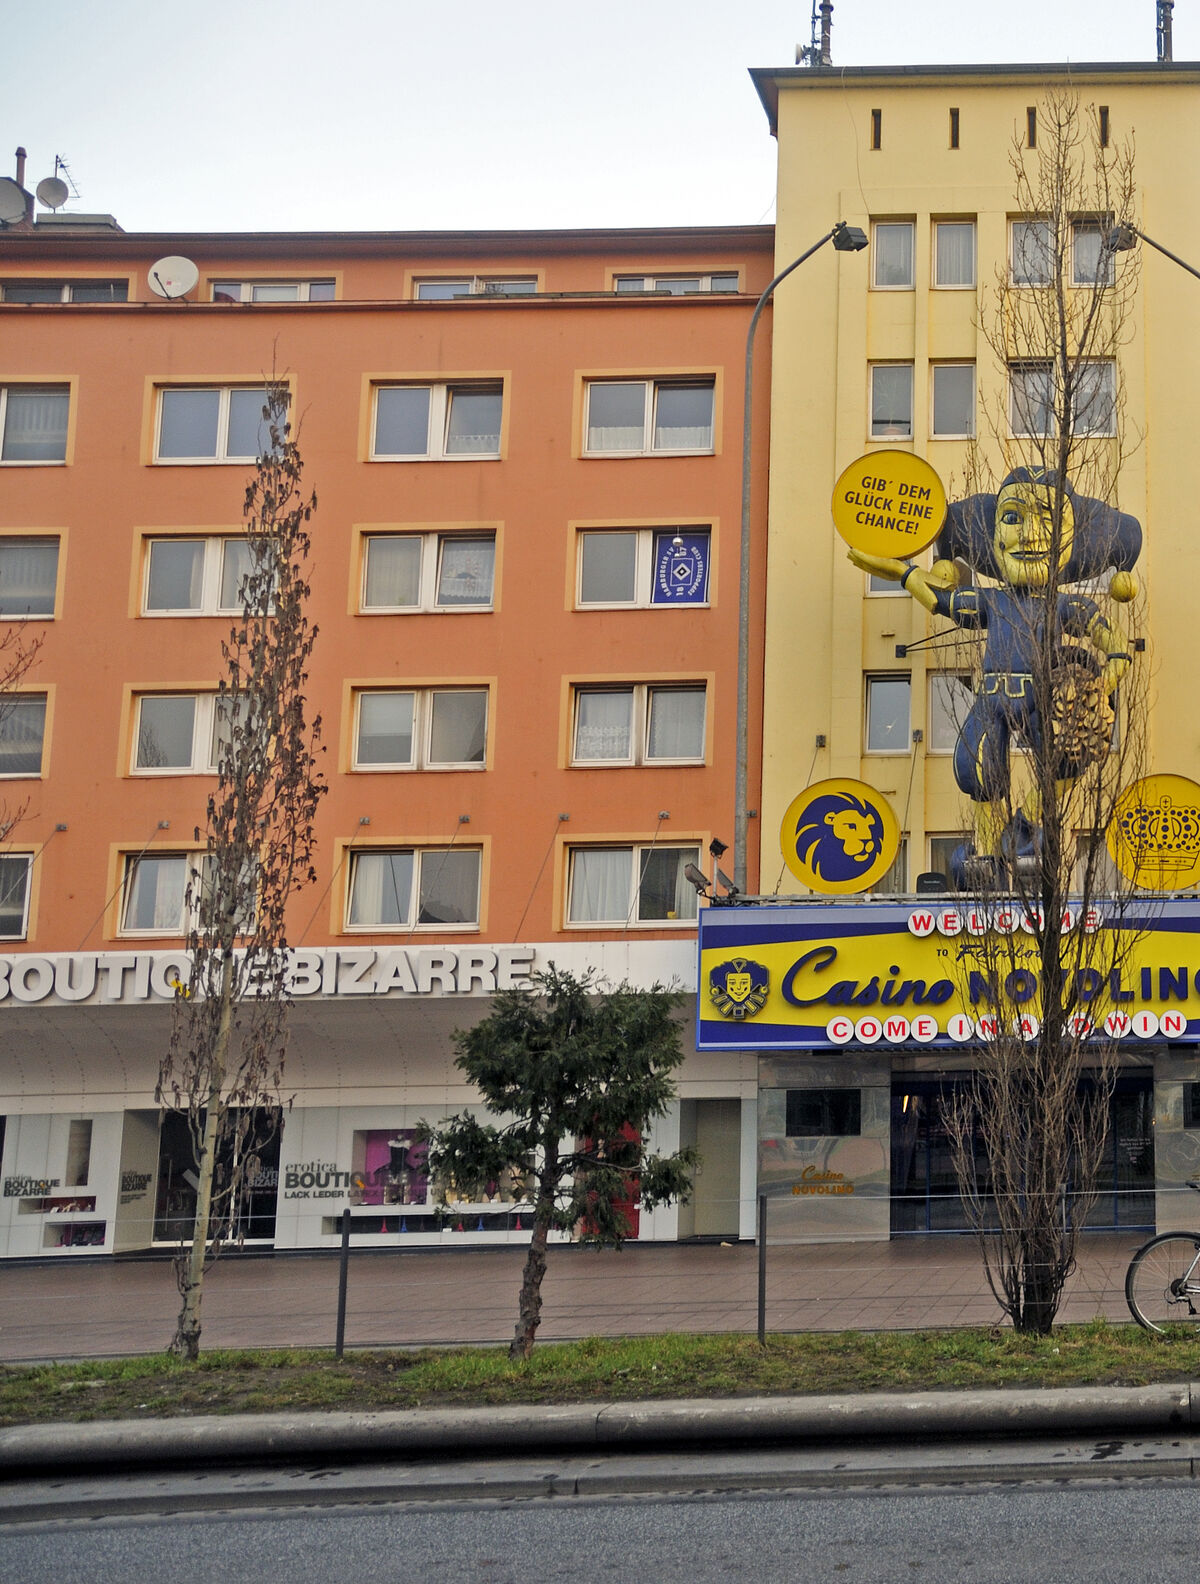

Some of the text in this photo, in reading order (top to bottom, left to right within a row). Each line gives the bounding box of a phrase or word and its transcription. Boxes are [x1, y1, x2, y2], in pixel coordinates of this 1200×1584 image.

[898, 483, 931, 500] DEM
[844, 491, 934, 519] GLÜCK EINE
[855, 511, 919, 535] CHANCE!
[936, 948, 949, 957] TO
[285, 947, 536, 995] BIZARRE
[782, 945, 955, 1007] Casino
[832, 1015, 1181, 1038] COME IN AD WIN
[285, 1159, 337, 1173] erotica
[801, 1164, 844, 1182] Casino
[3, 1187, 51, 1197] BIZARRE
[284, 1190, 310, 1199] LACK
[313, 1190, 344, 1199] LEDER
